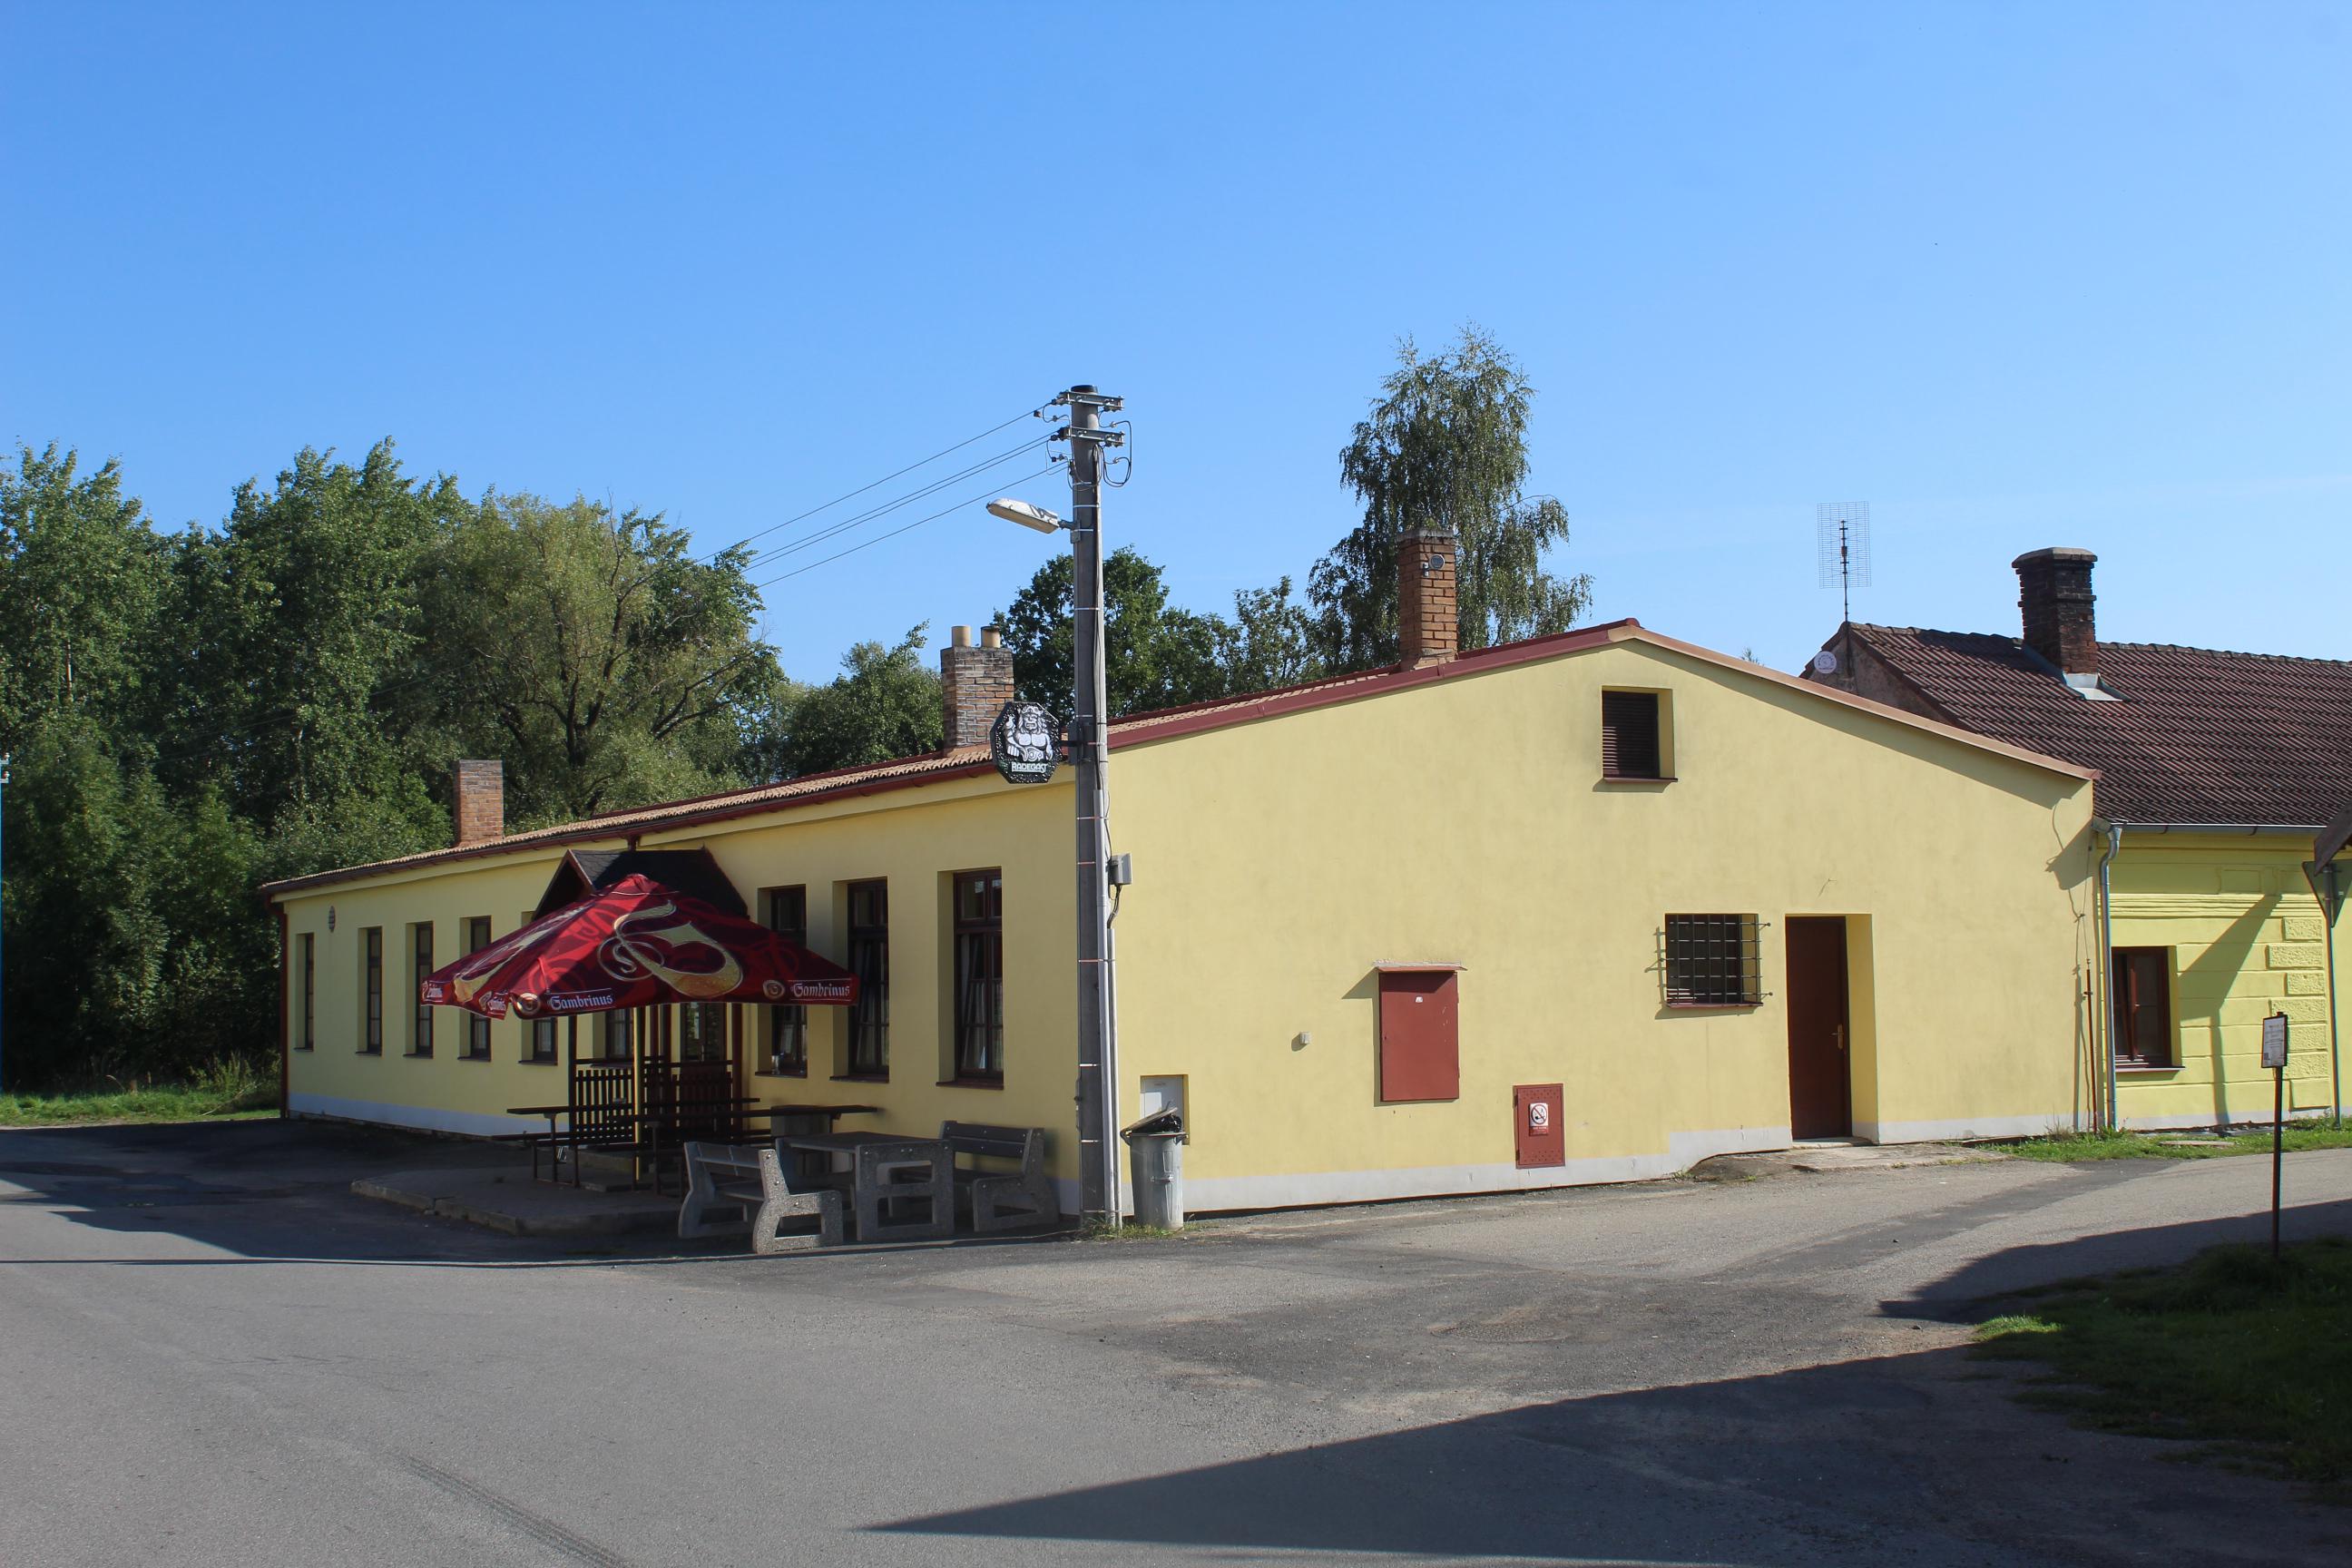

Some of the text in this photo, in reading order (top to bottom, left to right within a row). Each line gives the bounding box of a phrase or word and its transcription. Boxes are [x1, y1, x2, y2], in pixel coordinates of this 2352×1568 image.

[1011, 761, 1048, 773] RADEGAST
[791, 982, 850, 997] Gambrinus
[550, 995, 613, 1011] Gambrinus
